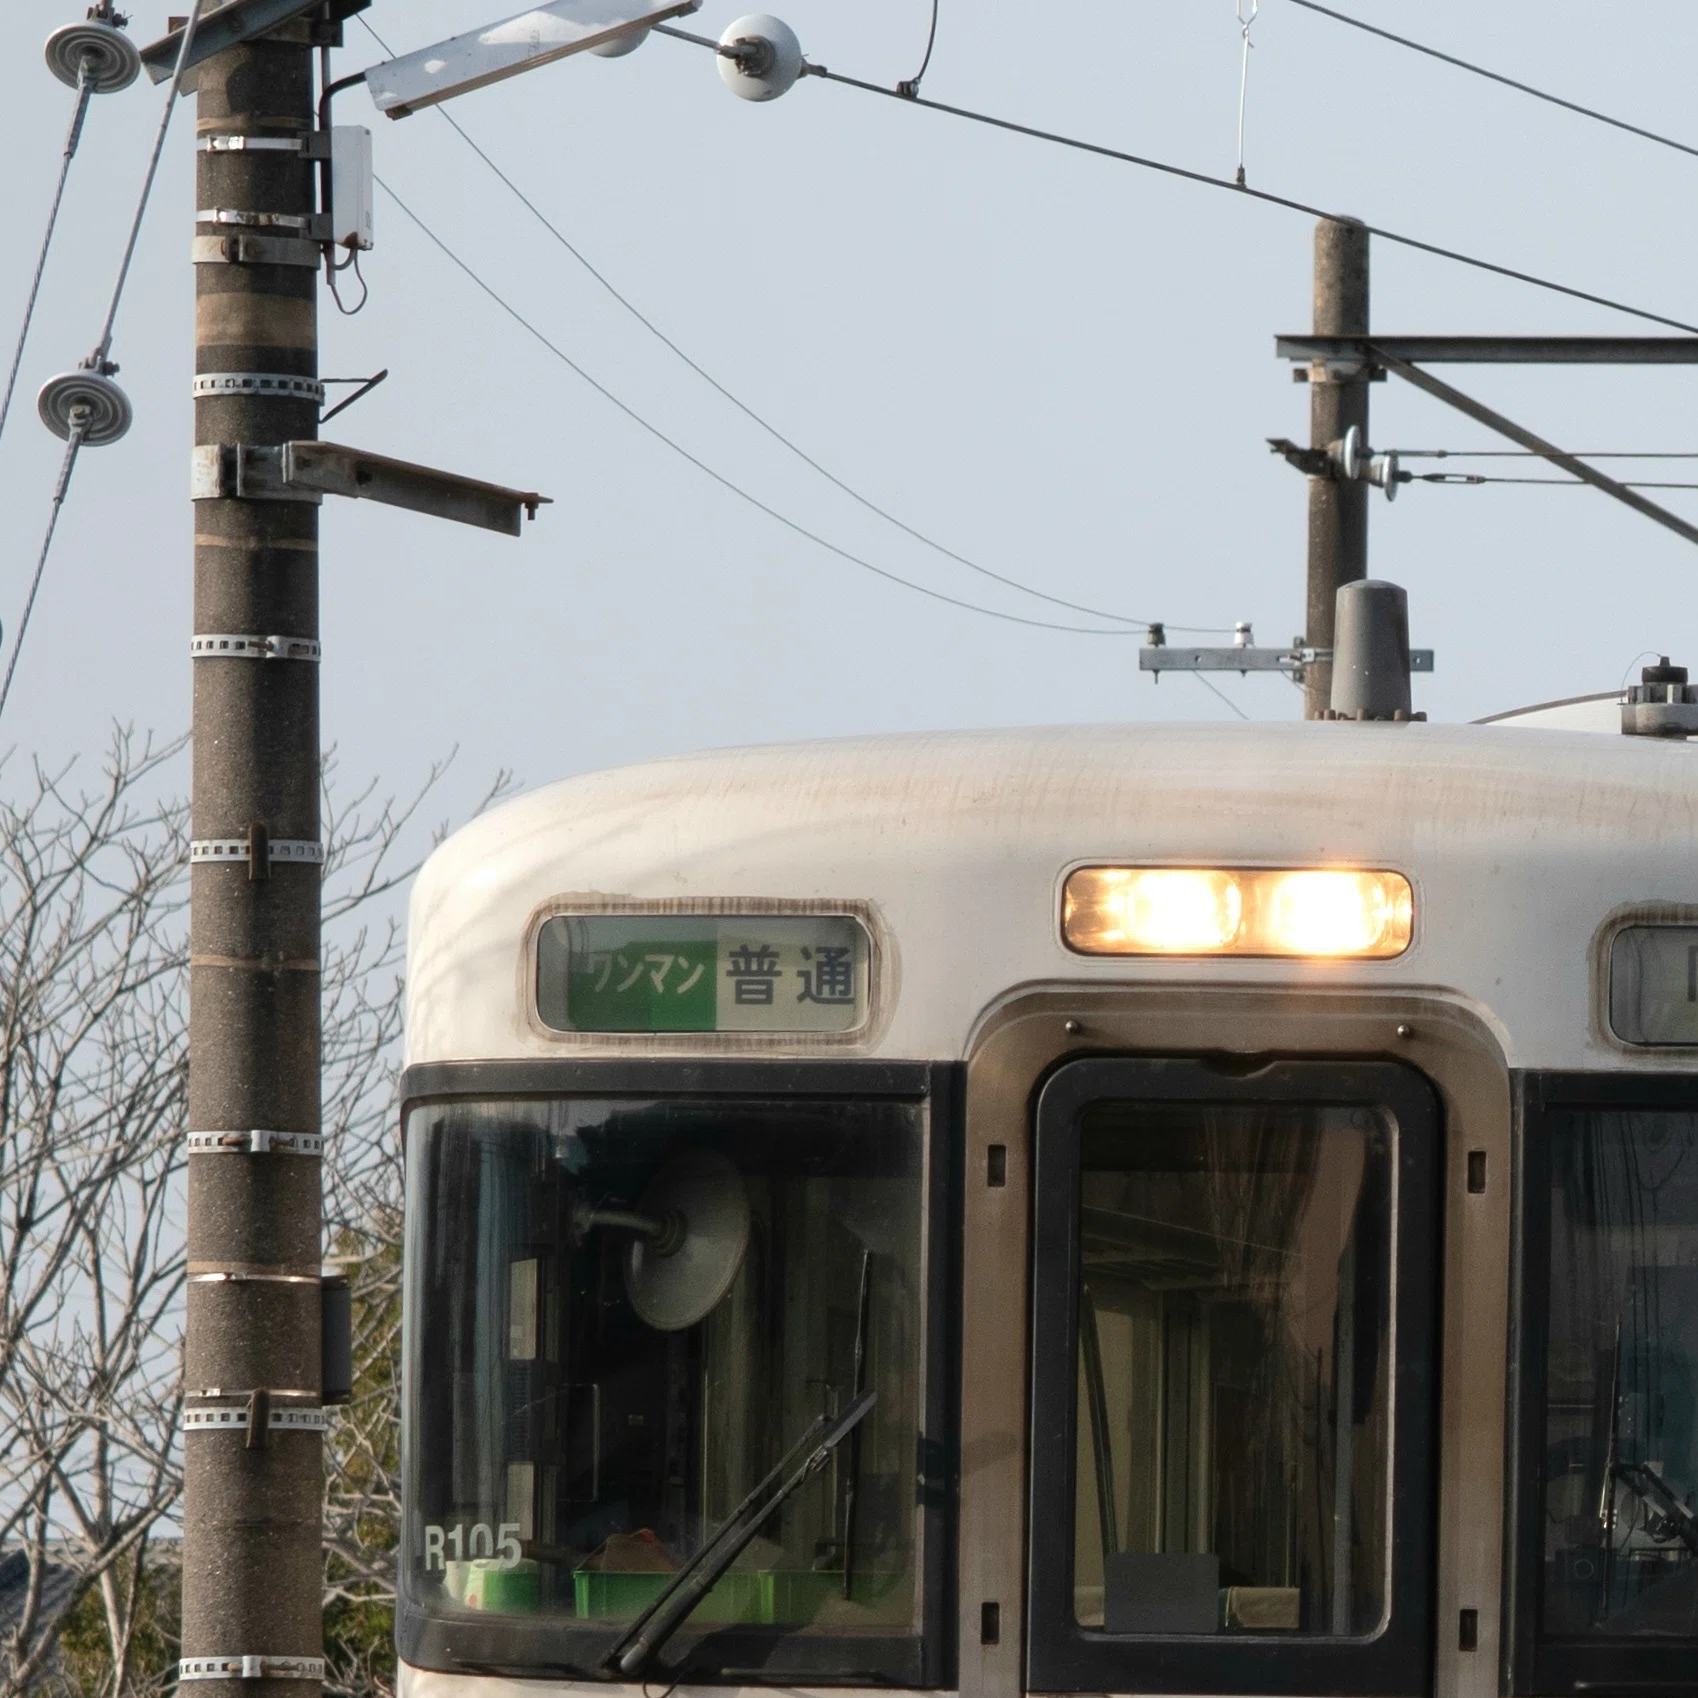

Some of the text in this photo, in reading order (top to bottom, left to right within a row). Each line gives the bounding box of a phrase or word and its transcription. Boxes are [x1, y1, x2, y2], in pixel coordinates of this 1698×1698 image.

[587, 943, 856, 1006] ワンマン 普通
[424, 1522, 523, 1572] R105
